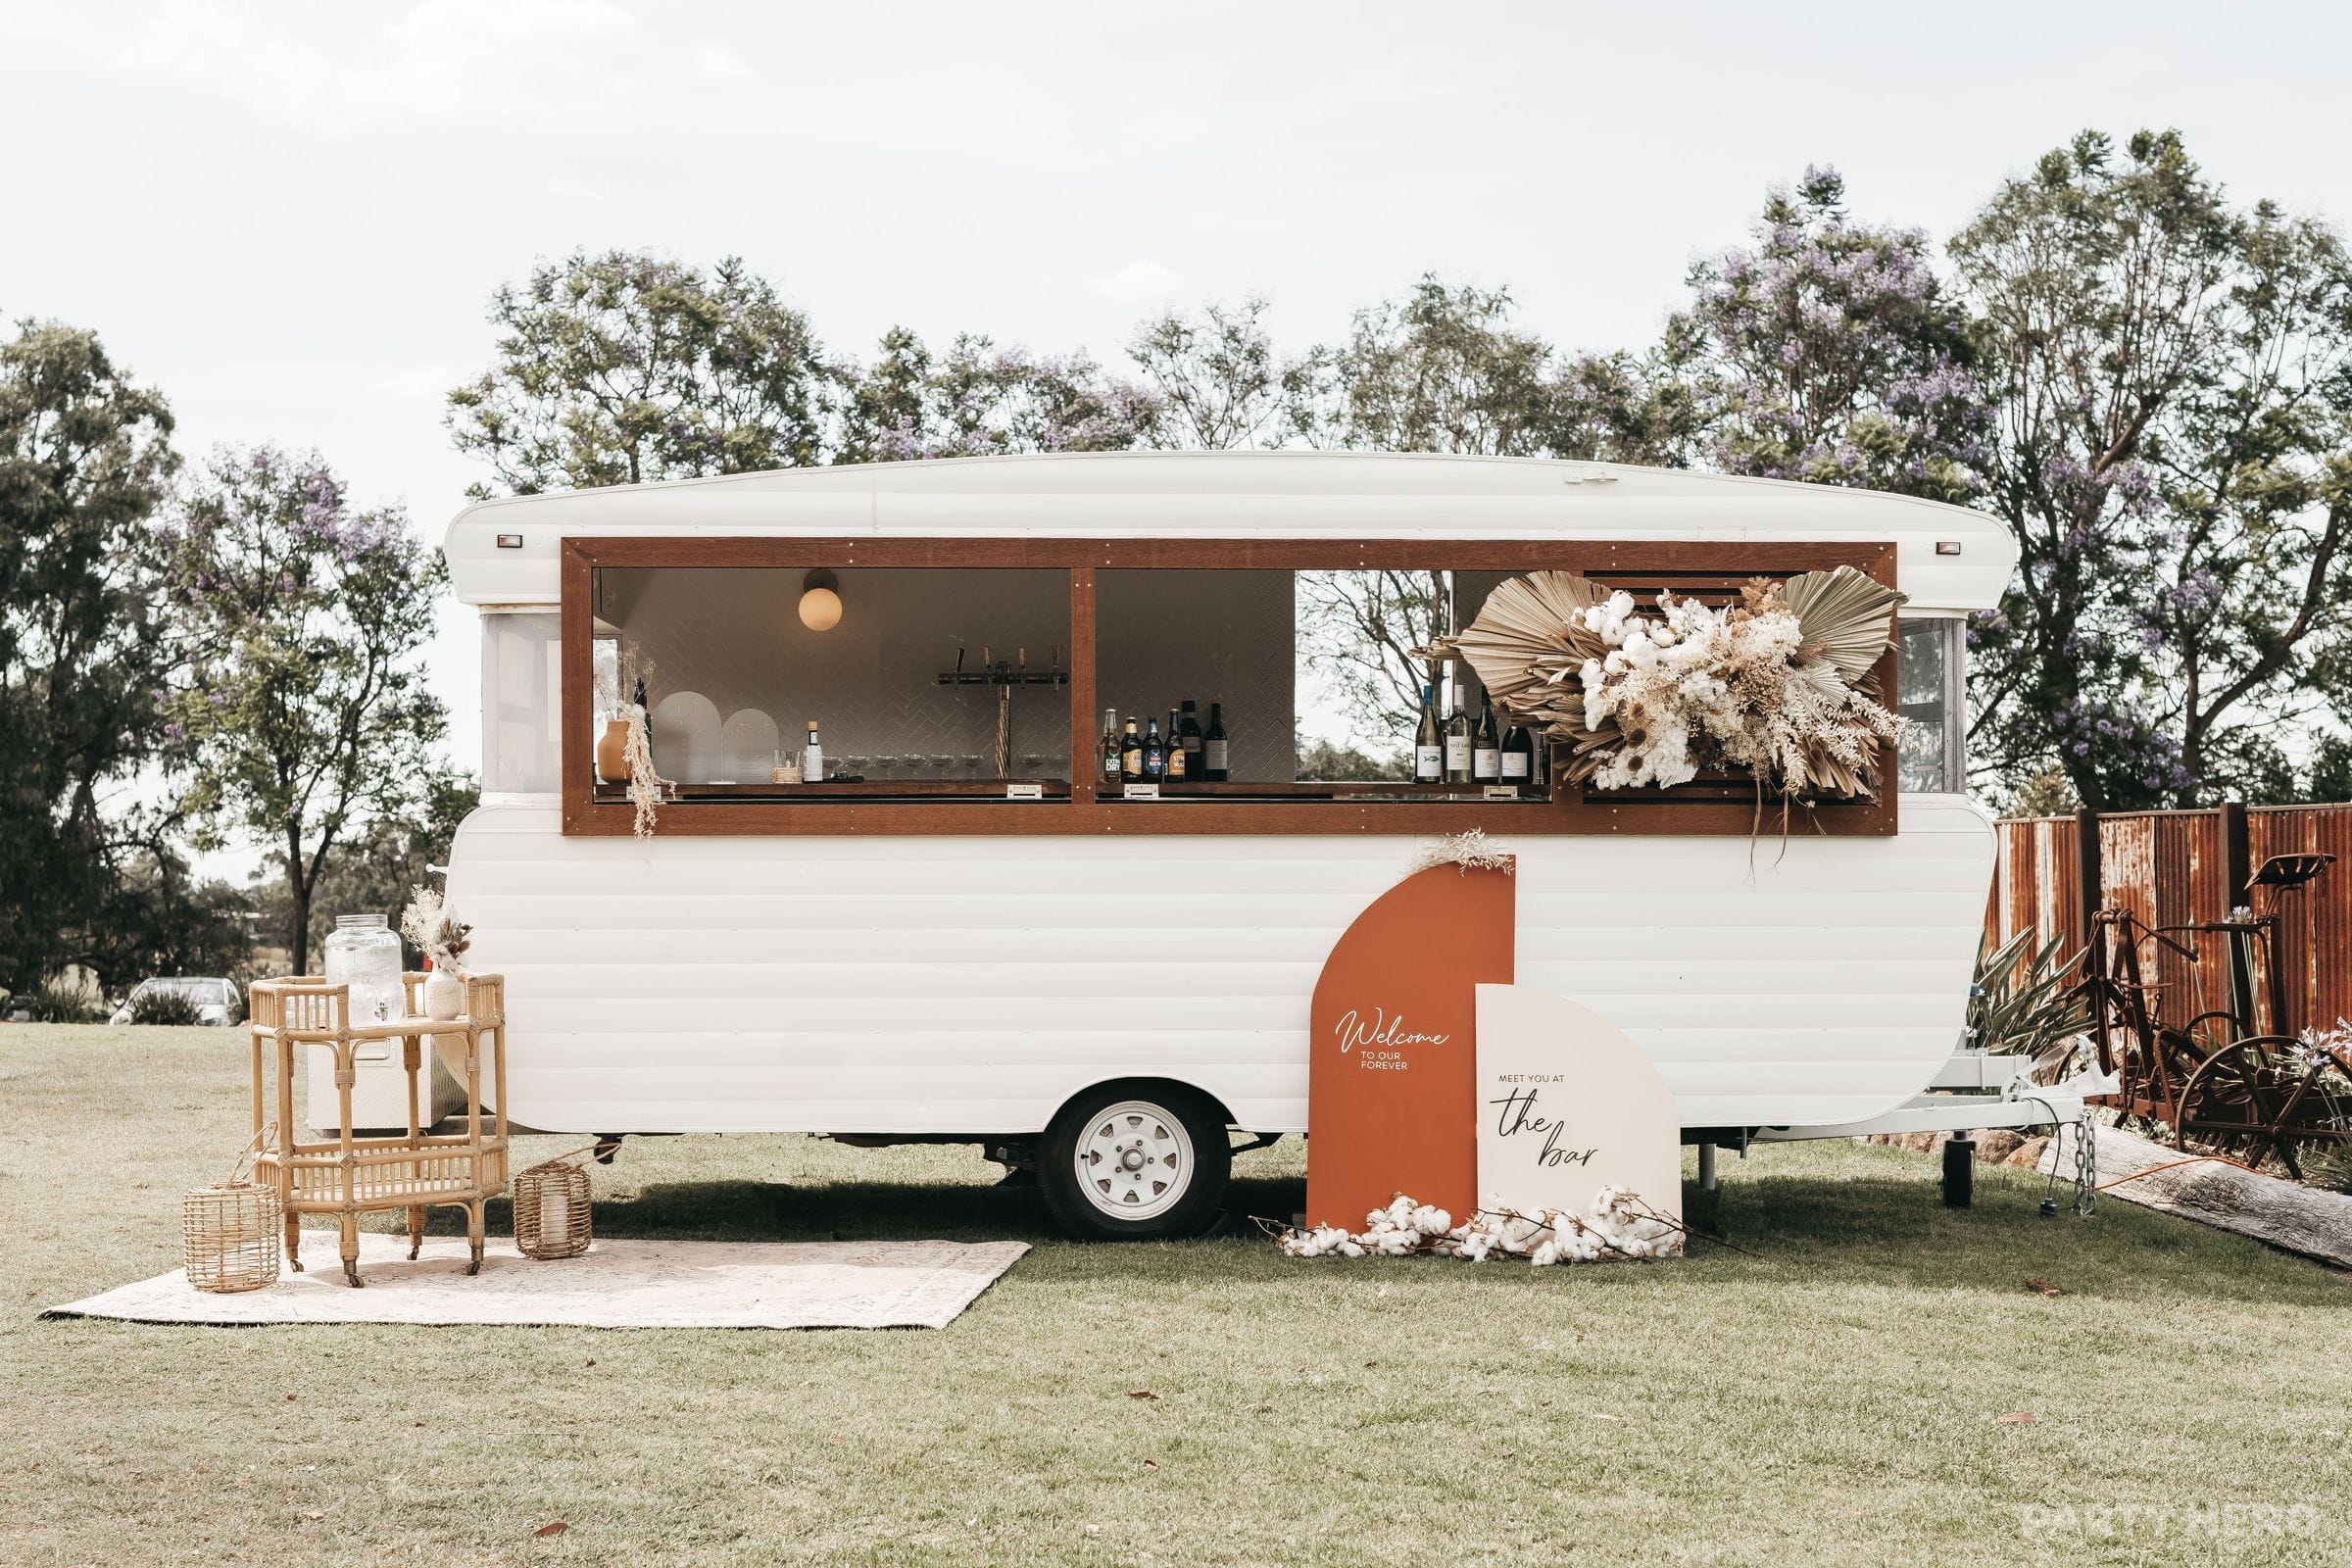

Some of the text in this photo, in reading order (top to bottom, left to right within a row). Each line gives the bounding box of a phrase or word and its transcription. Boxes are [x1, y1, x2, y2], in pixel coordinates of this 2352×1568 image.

[1335, 1006, 1450, 1054] Welcome
[1360, 1051, 1400, 1060] TO OUR
[1361, 1060, 1408, 1070] FOREVER
[1498, 1074, 1565, 1083] MEET YOU AT
[1489, 1087, 1552, 1137] the
[1538, 1120, 1598, 1167] bar
